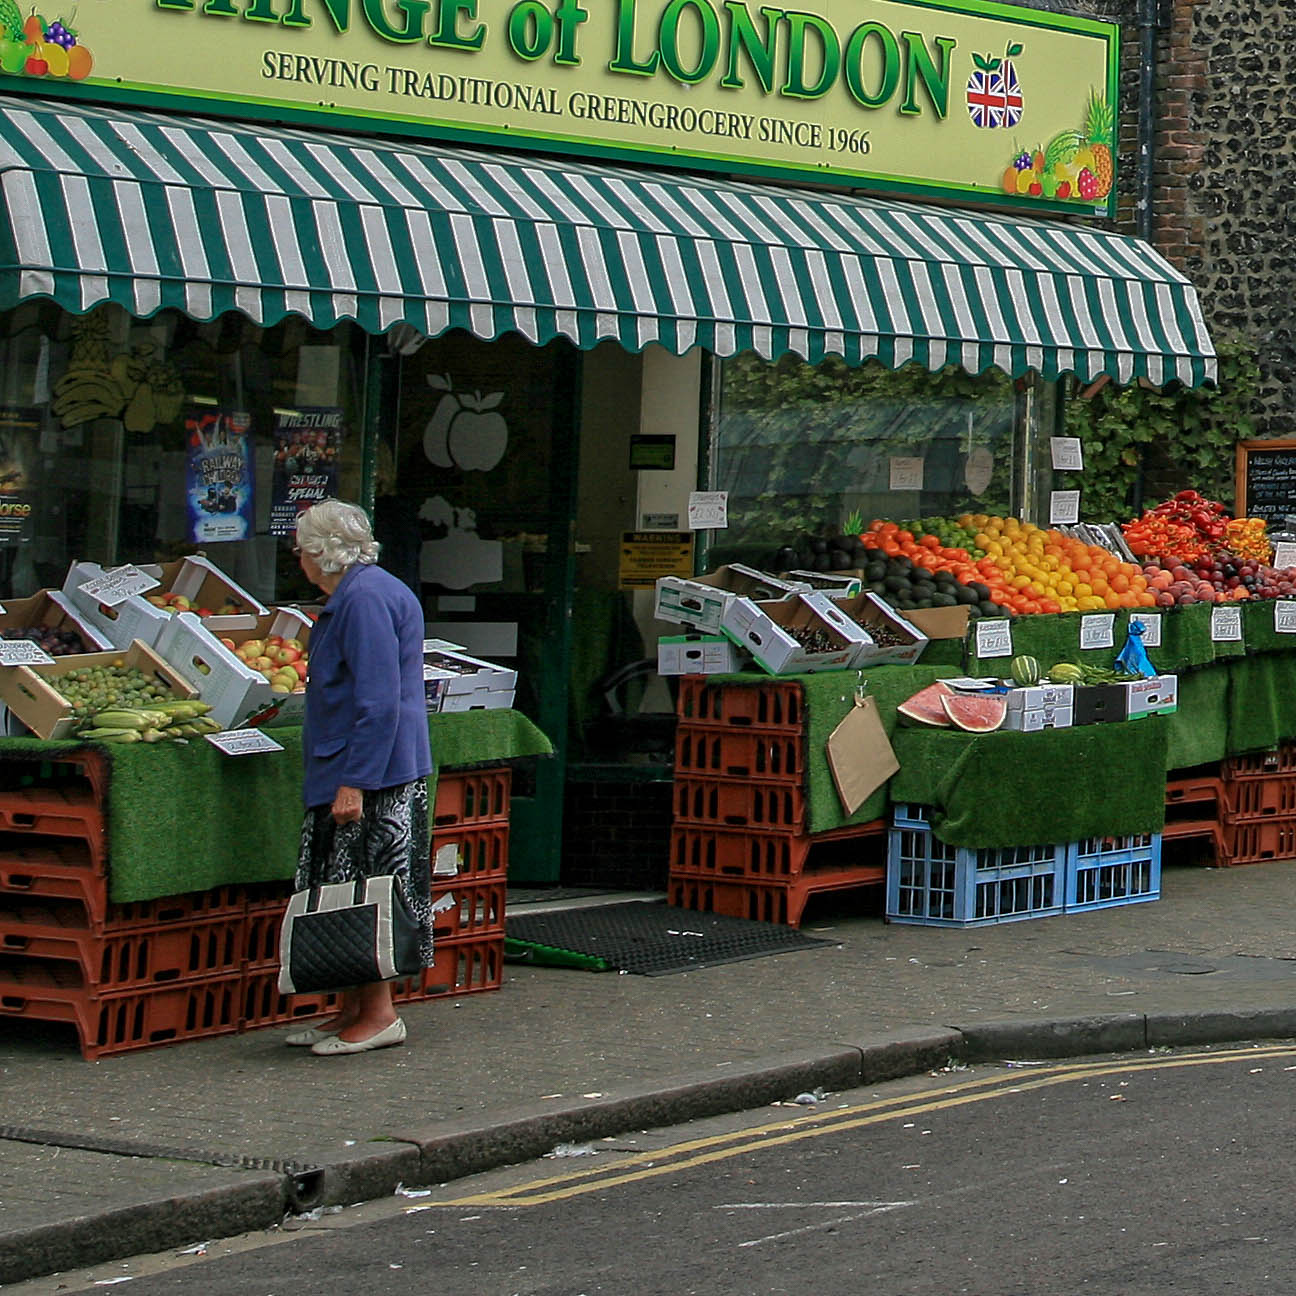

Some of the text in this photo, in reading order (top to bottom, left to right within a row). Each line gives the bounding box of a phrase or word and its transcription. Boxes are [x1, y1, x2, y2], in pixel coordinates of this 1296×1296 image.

[262, 50, 871, 155] SERVING TRADITIONAL GREENGROCERY SINCE 1966
[280, 413, 340, 428] WRESTLING
[0, 499, 31, 516] orse
